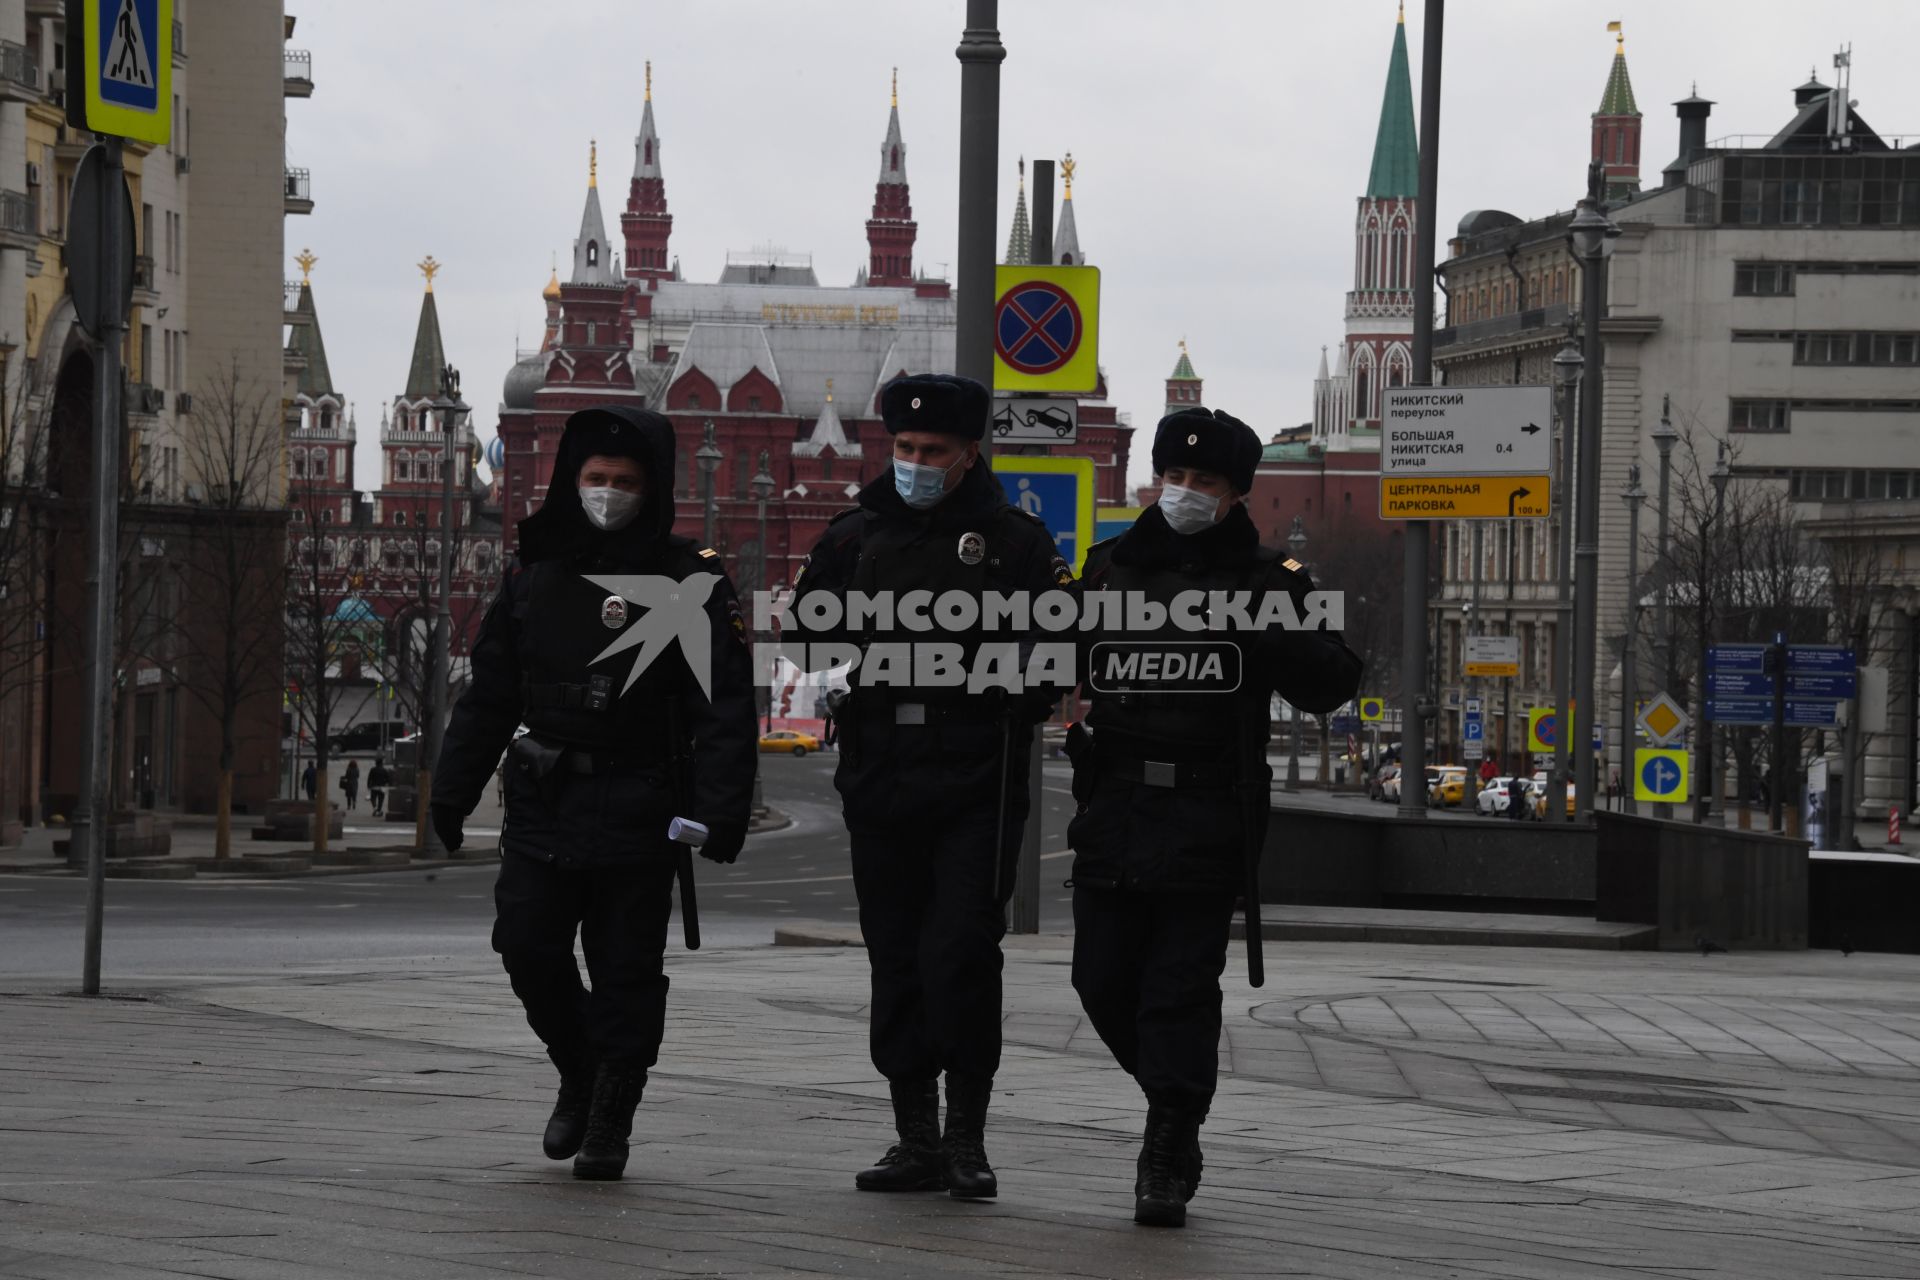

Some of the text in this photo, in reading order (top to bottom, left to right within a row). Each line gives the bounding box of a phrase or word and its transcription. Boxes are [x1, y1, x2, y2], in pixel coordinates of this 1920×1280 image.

[1391, 394, 1464, 406] НИКИТСКИЙ
[1391, 409, 1446, 419] переулок
[1391, 431, 1453, 441] БОЛЬШАЯ
[1391, 443, 1513, 455] НИКИТСКАЯ 0.4
[1391, 458, 1426, 468] улица
[1390, 484, 1481, 497] ЦЕНТРАЛЬНАЯ
[1390, 500, 1456, 511] ПАРКОВКА
[1518, 507, 1533, 515] 100
